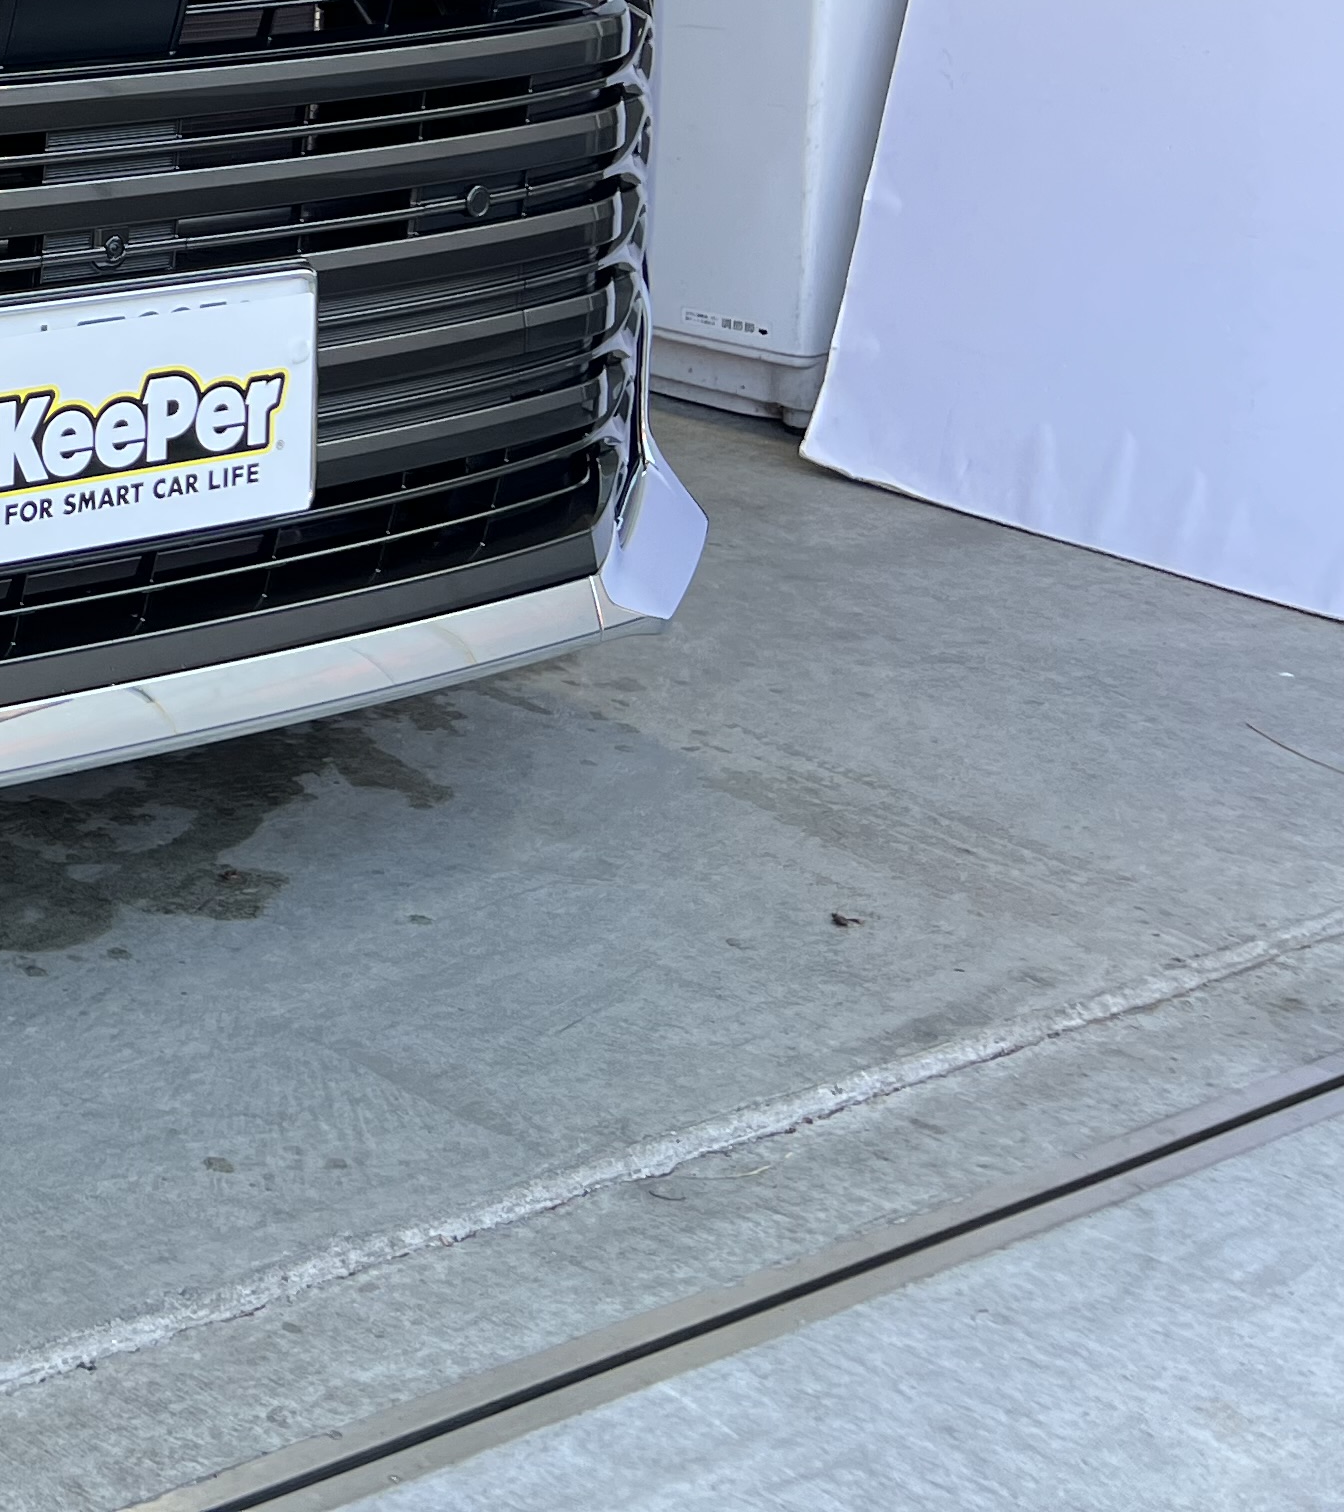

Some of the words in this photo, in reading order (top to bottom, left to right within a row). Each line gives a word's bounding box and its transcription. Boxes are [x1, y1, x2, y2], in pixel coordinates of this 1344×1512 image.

[4, 497, 54, 526] FOR
[62, 481, 144, 516] SMART
[152, 474, 199, 500] CAR
[208, 462, 260, 491] LIFE
